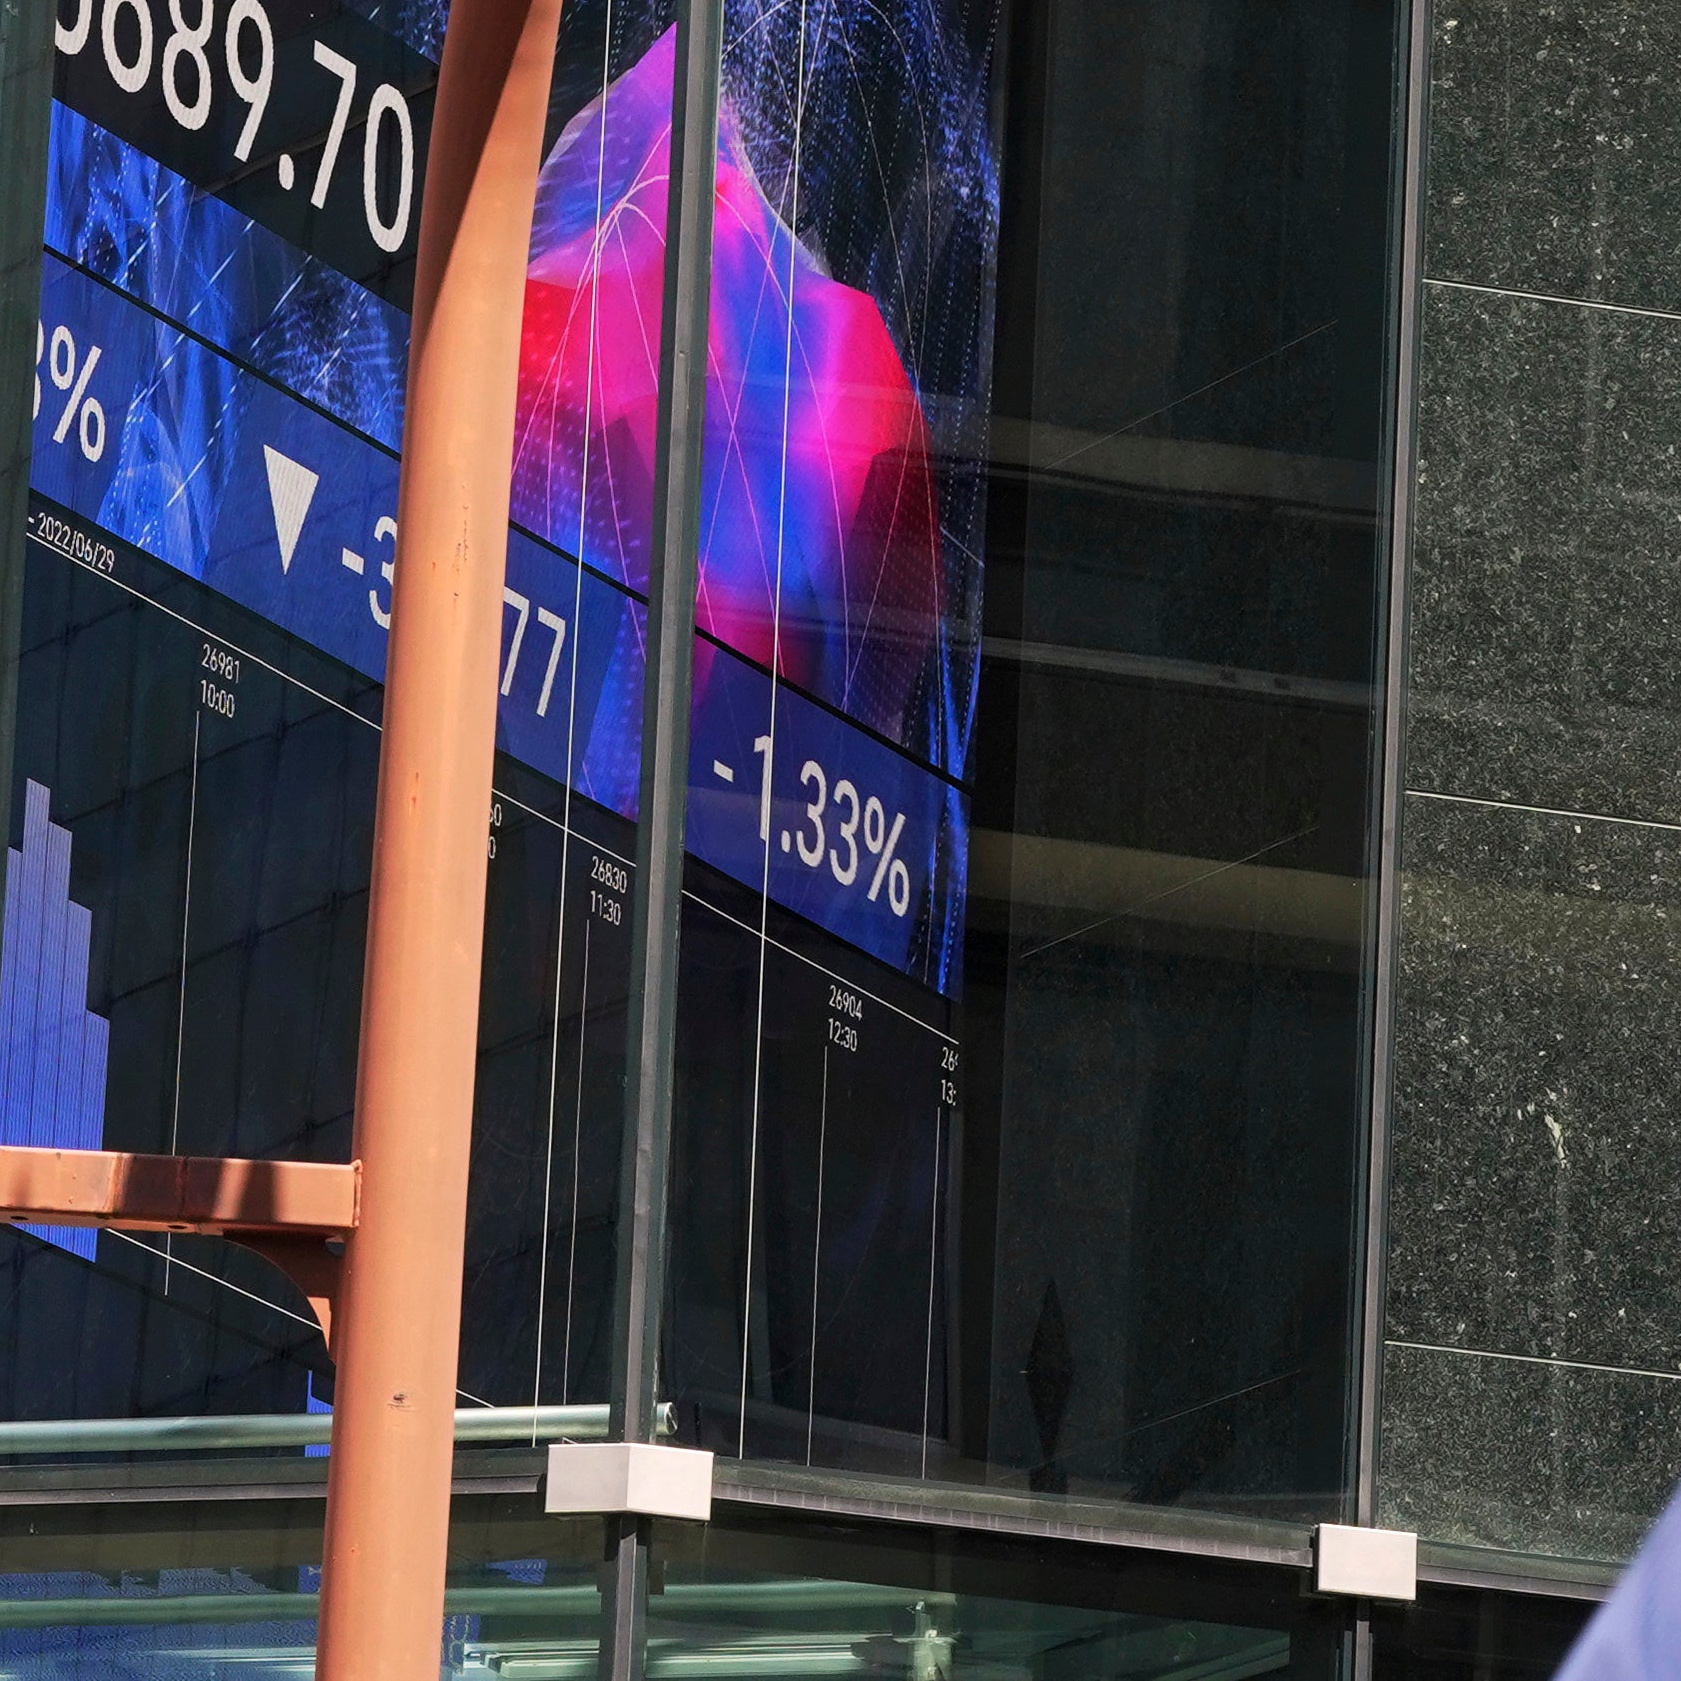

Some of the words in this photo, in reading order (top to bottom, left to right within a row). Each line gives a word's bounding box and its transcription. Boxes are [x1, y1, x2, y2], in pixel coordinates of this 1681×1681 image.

[37, 512, 116, 573] 2022/06/29
[201, 643, 241, 685] 26981
[200, 679, 236, 718] 10:00
[713, 734, 911, 918] -1.33%
[590, 855, 628, 894] 26830
[590, 890, 622, 926] 11:30
[828, 984, 863, 1021] 26904
[828, 1018, 858, 1052] 12:30
